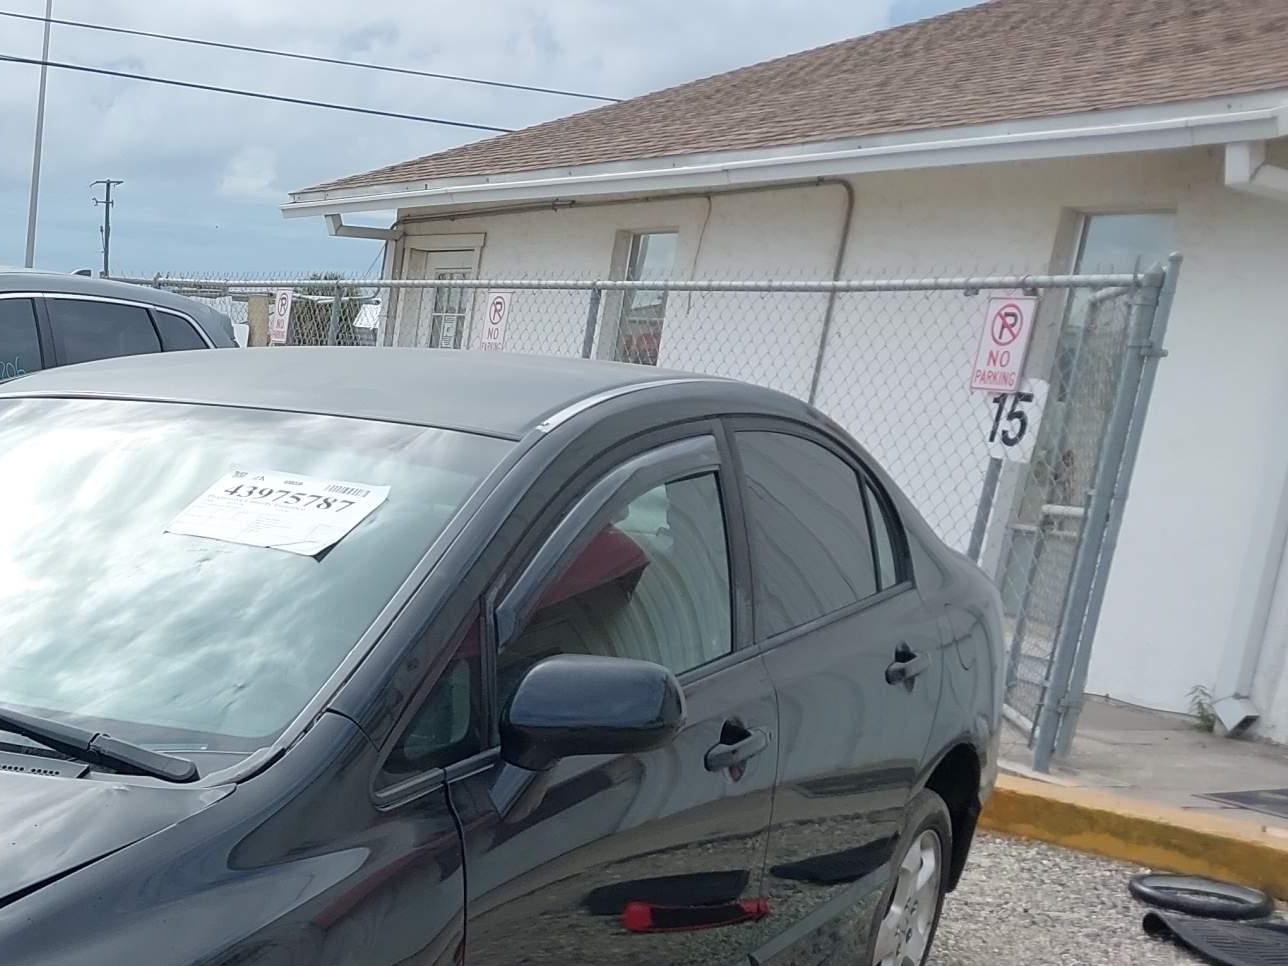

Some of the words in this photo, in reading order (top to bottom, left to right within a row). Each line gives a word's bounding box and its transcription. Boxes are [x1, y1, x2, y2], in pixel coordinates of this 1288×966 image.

[487, 327, 499, 340] NO
[986, 350, 1011, 368] NO
[974, 369, 1017, 386] PARKING
[988, 391, 1034, 447] 15
[223, 483, 358, 513] 43975787
